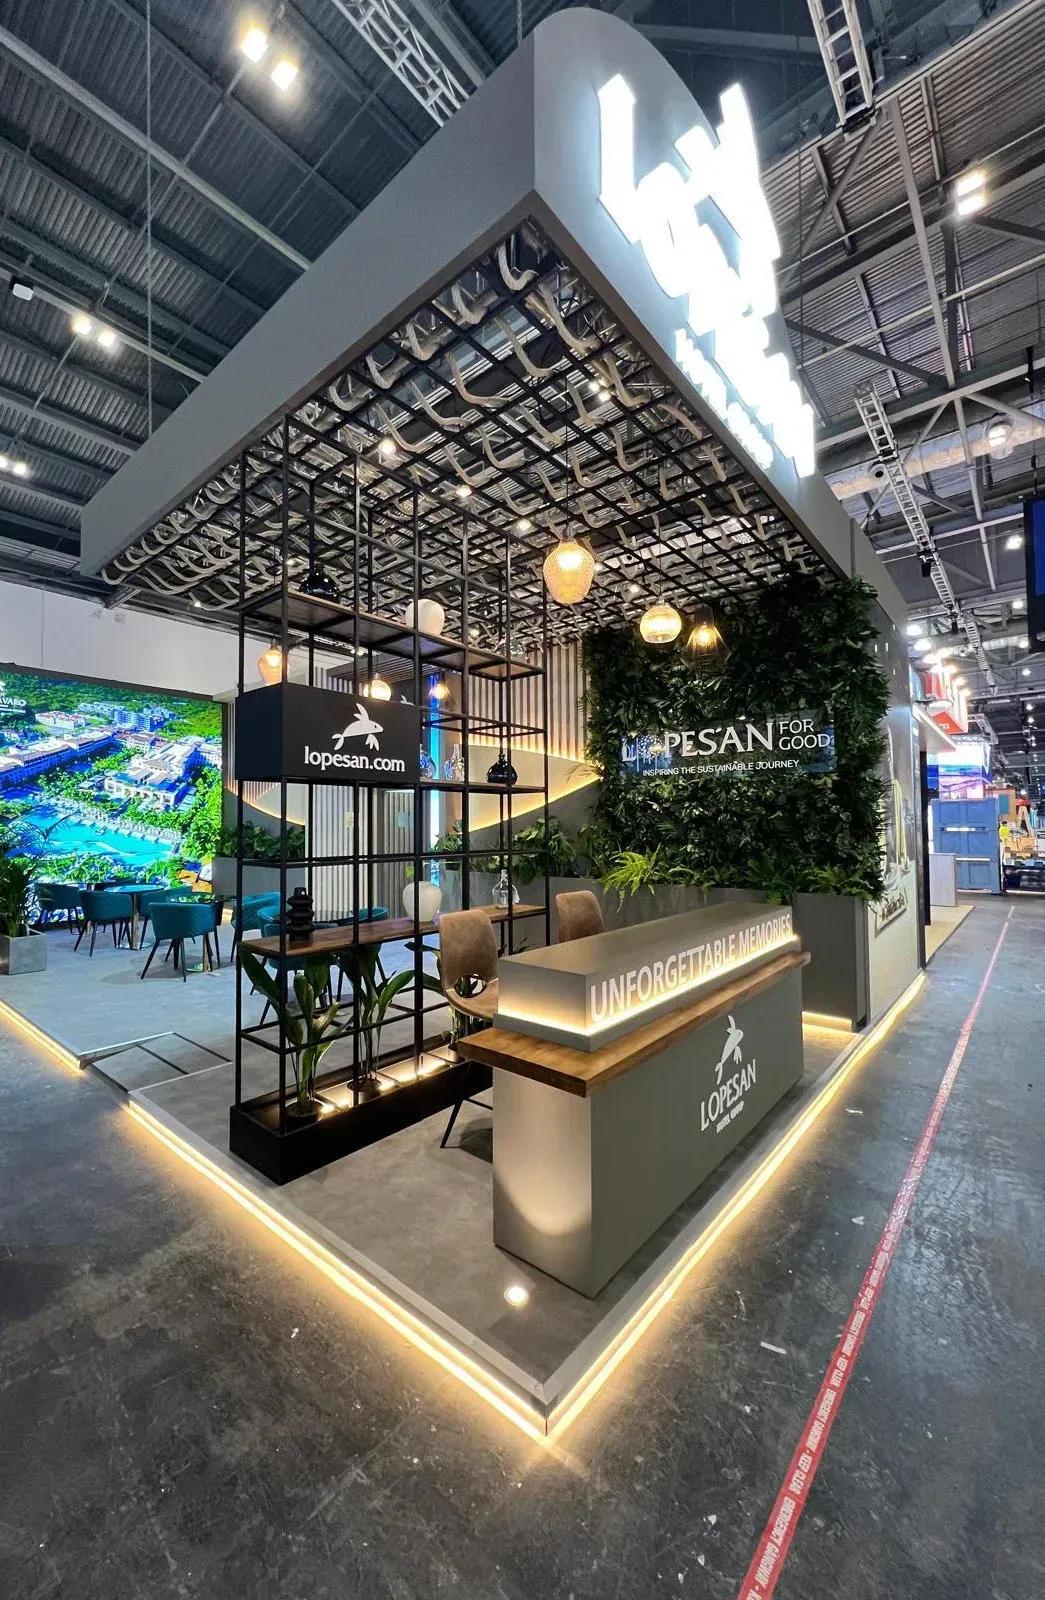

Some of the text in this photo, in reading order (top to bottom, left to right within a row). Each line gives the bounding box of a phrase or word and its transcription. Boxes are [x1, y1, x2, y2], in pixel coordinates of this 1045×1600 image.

[779, 719, 814, 735] FOR
[779, 733, 831, 751] GOOD
[304, 746, 405, 772] lopesan.com
[642, 759, 800, 777] INSPIRING THE SUSTAINABLE JOURNEY
[590, 933, 736, 1023] UNFORGETTABLE
[701, 1059, 756, 1131] LOPESAN
